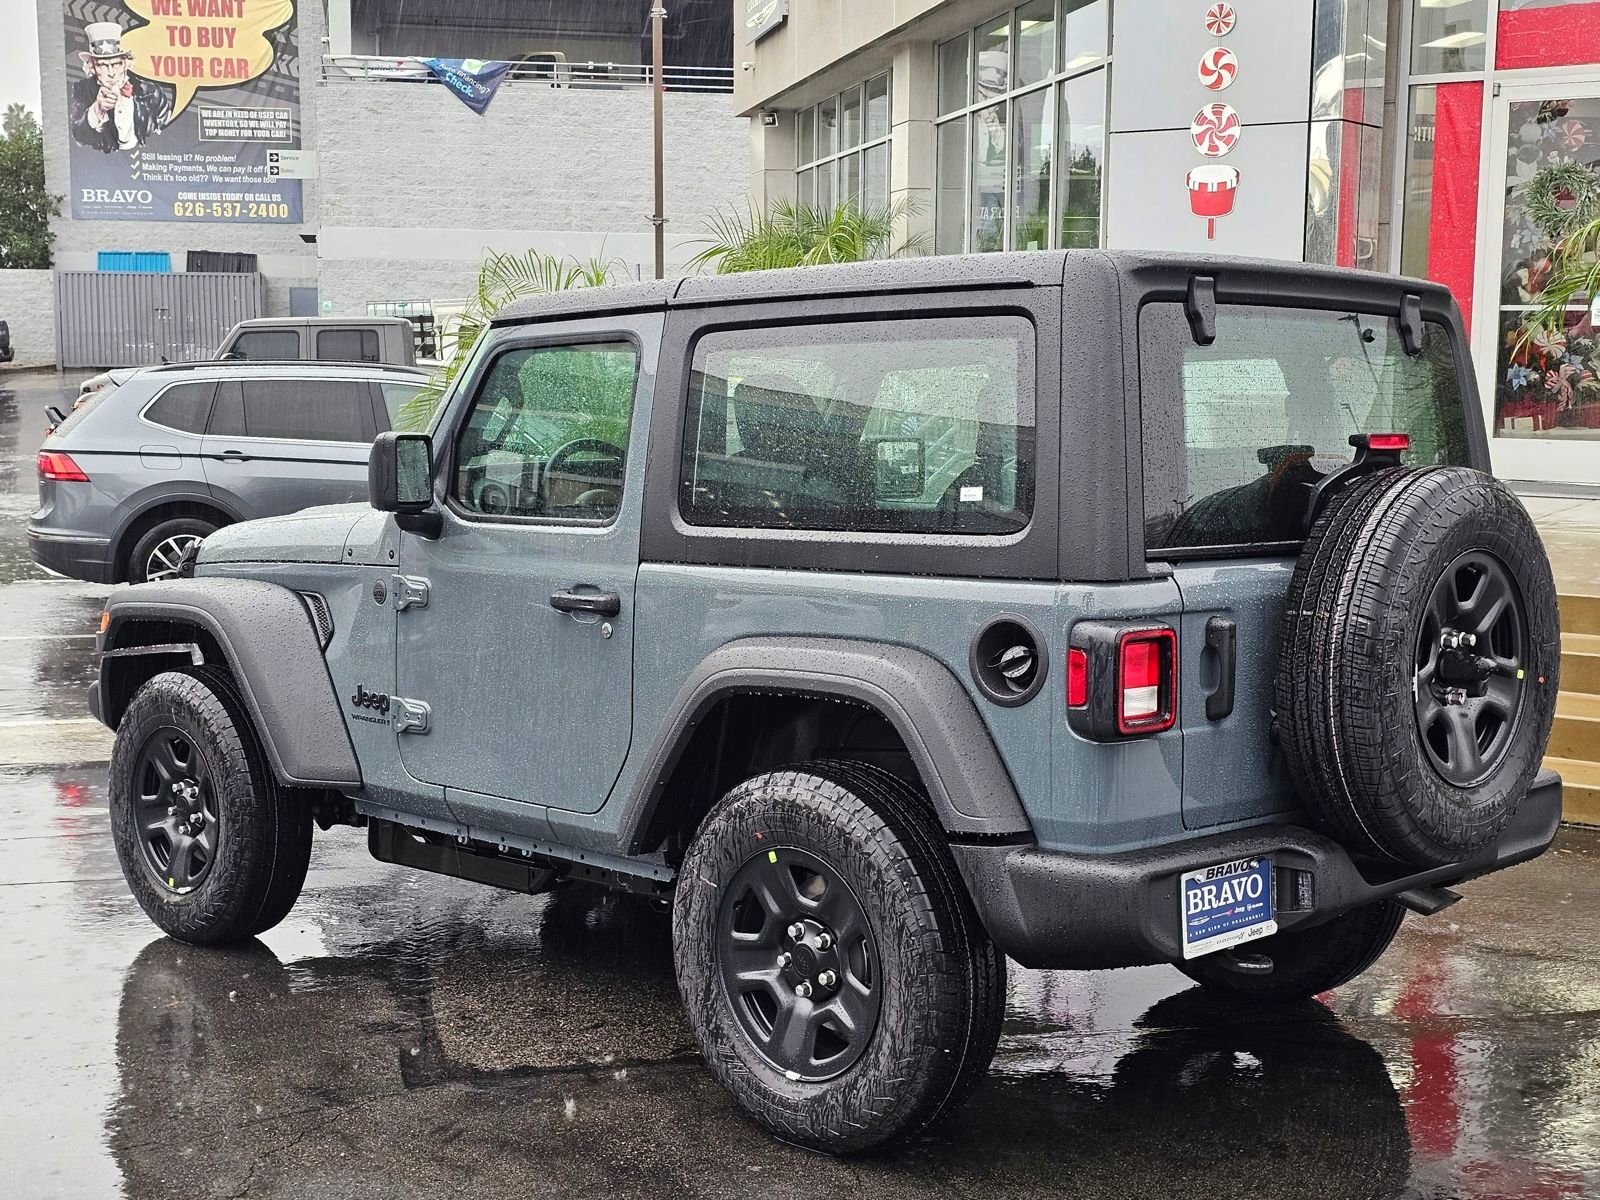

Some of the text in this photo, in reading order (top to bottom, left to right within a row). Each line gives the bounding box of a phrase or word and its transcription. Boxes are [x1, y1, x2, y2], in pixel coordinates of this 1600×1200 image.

[150, 0, 246, 18] WE WANT
[165, 25, 238, 49] TO BUY
[150, 55, 249, 79] YOUR CAR
[438, 63, 491, 95] Auto financing?
[445, 72, 474, 98] Check.
[201, 110, 288, 120] WE ARE IN NEED OF USED CAR
[203, 119, 240, 128] INVENTORY,
[240, 120, 249, 128] SO
[249, 120, 260, 128] WE
[275, 121, 287, 129] PAY
[204, 128, 217, 137] TOP
[218, 129, 240, 137] MONEY
[240, 129, 253, 137] FOR
[253, 129, 270, 138] YOUR
[141, 152, 156, 161] Still
[156, 153, 183, 163] leasing
[183, 154, 193, 162] it?
[205, 155, 237, 163] problem!
[142, 163, 167, 173] Making
[169, 163, 205, 173] Payments,
[232, 167, 246, 175] pay
[246, 165, 253, 173] it
[253, 165, 264, 173] off
[142, 173, 162, 181] Think
[163, 173, 175, 182] it's
[175, 174, 188, 182] too
[188, 174, 209, 182] old??
[211, 175, 224, 183] We
[224, 175, 241, 183] want
[242, 176, 263, 184] those
[81, 188, 153, 204] BRAVO
[177, 192, 282, 202] COME INSIDE TODAY OR CALL US
[174, 201, 289, 218] 626-537-2400
[351, 684, 391, 716] Jeep
[1187, 873, 1264, 915] BRAVO
